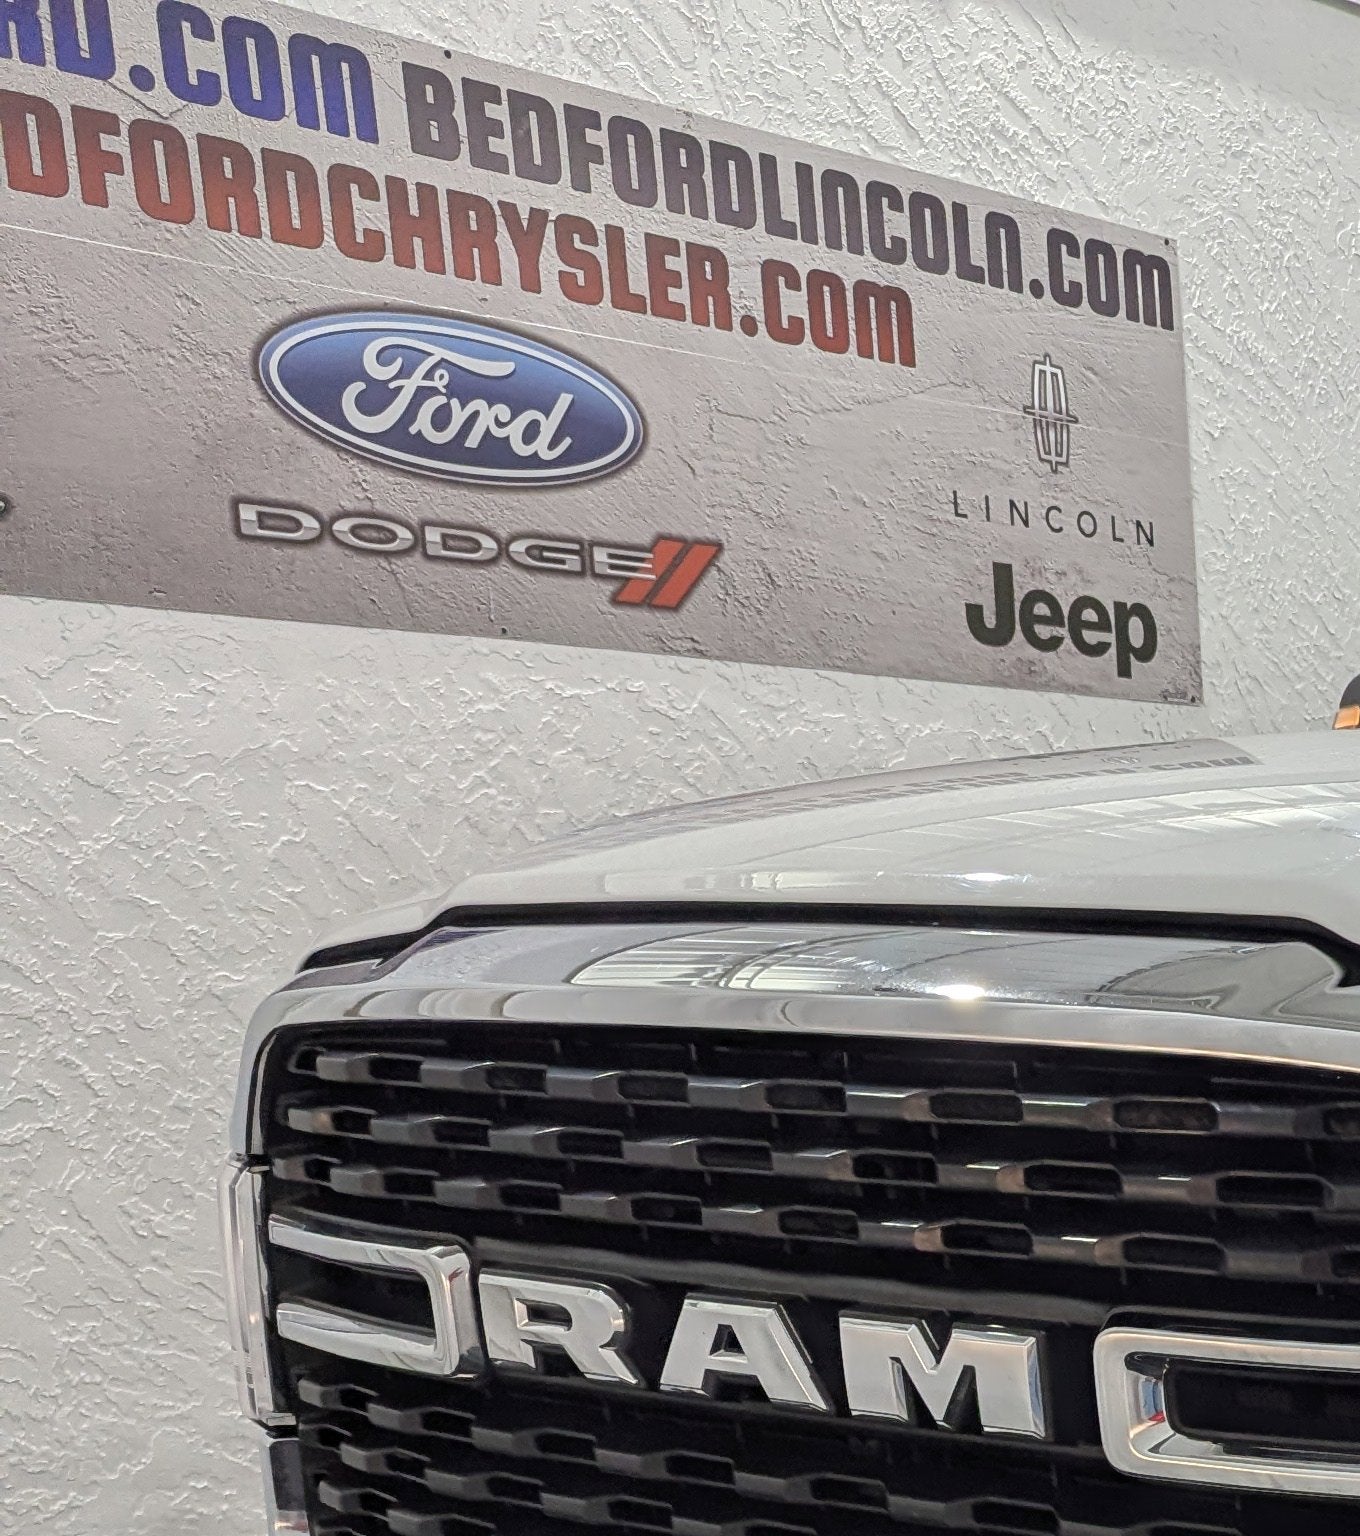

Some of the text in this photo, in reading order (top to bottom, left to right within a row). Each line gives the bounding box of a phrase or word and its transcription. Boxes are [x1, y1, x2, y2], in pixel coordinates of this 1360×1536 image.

[0, 89, 916, 368] DFORDCHRYSLER.COM
[402, 61, 1174, 331] BEDFORDLINCOLN.COM
[342, 336, 574, 461] Ford
[239, 503, 657, 581] DODGE
[953, 490, 1155, 547] LINCOLN
[965, 562, 1158, 679] Jeep
[480, 1269, 1047, 1440] RAM
